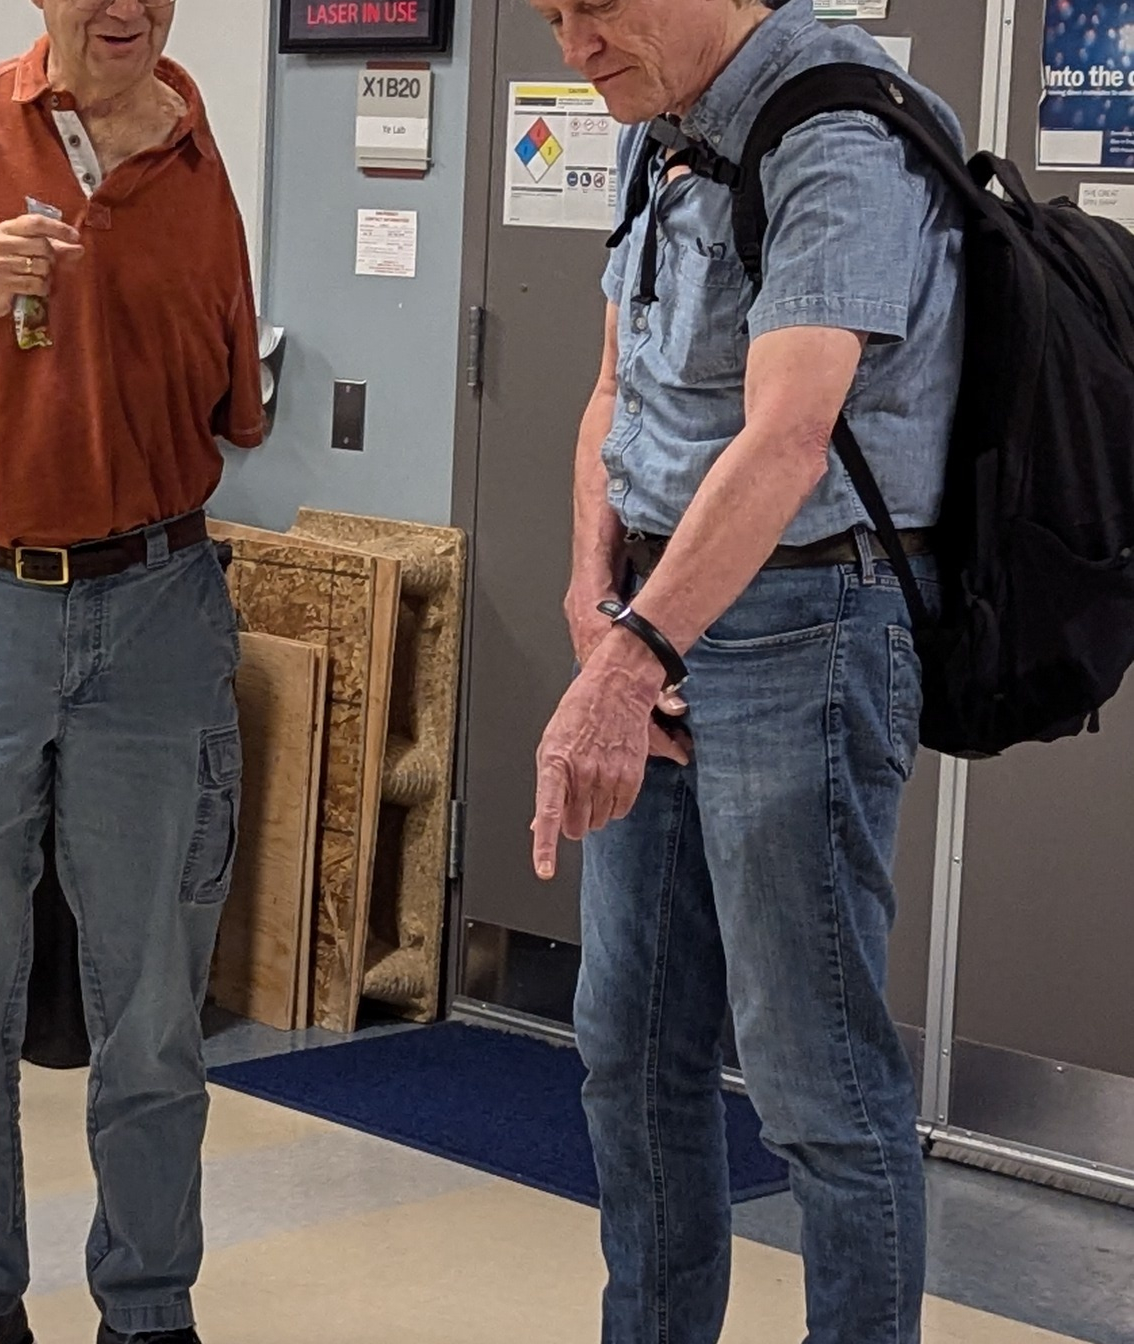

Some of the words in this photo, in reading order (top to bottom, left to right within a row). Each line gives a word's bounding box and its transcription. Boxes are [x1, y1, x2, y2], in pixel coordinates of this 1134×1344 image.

[307, 2, 359, 25] LASER
[362, 2, 379, 23] IN
[384, 1, 417, 22] USE
[362, 76, 421, 98] X1B20
[1045, 65, 1085, 87] Into
[1088, 65, 1124, 87] the
[393, 125, 406, 134] Lab
